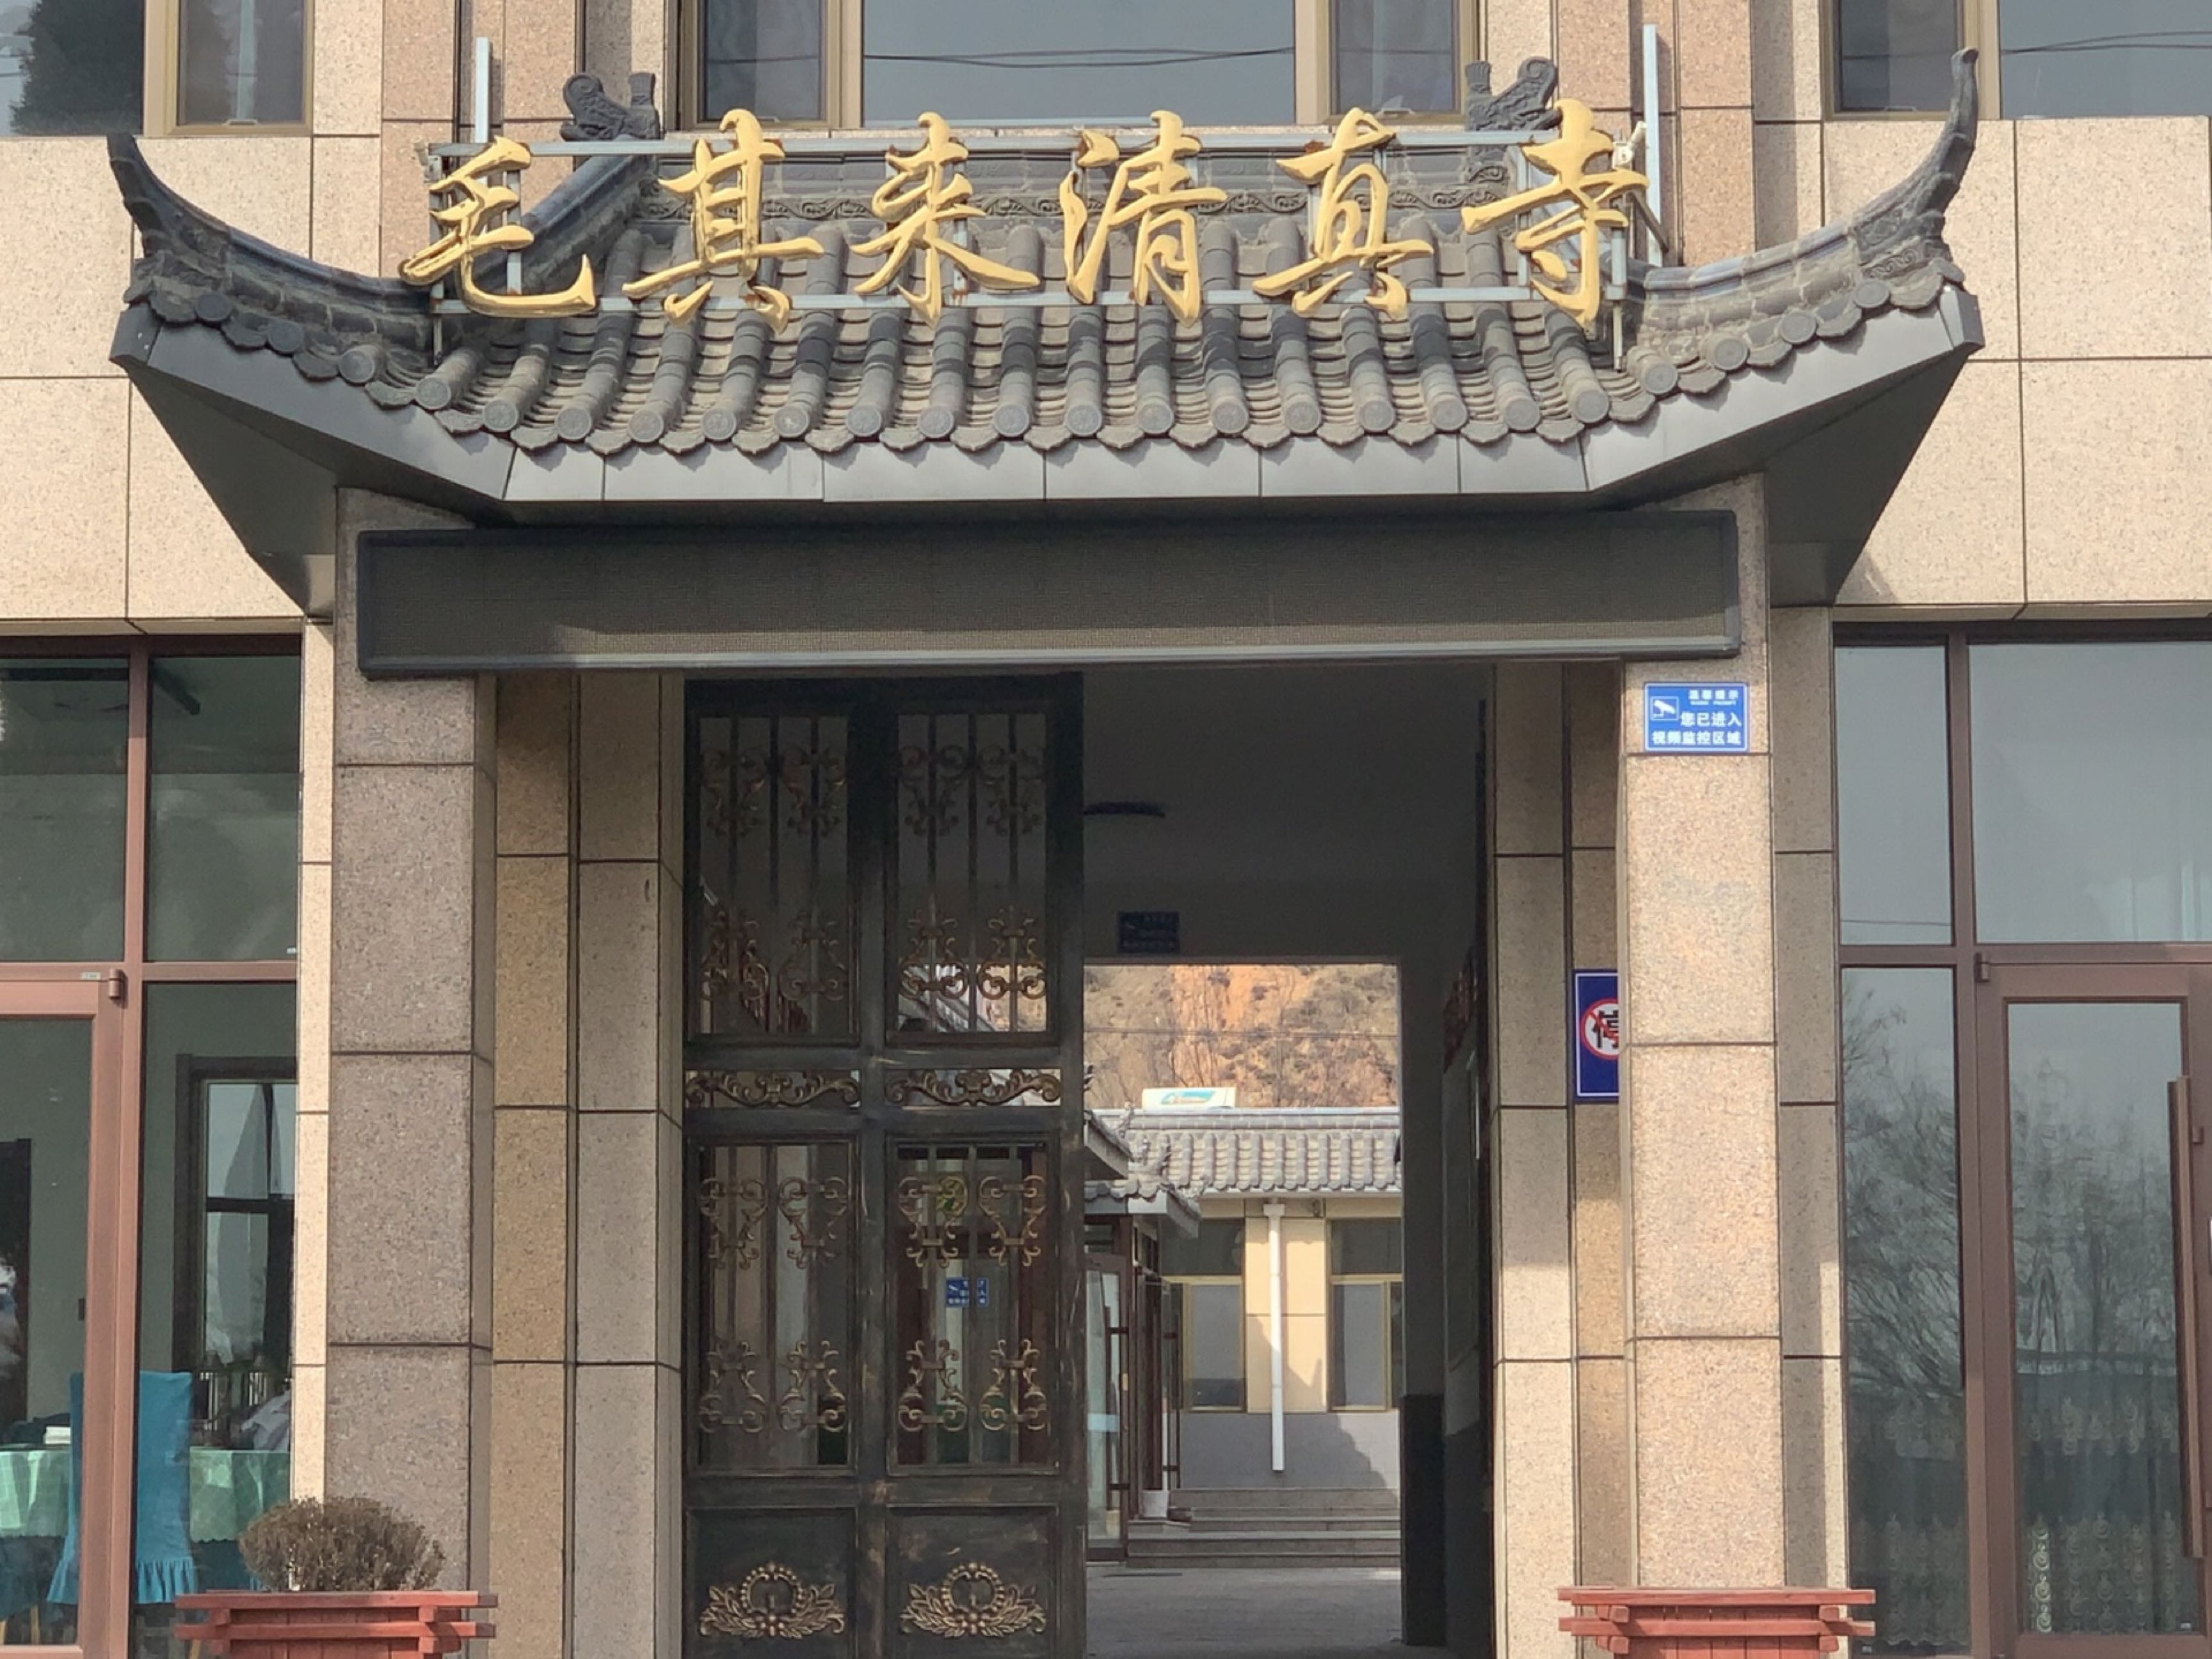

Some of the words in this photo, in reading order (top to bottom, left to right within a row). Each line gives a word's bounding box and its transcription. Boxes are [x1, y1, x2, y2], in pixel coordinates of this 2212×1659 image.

[1681, 711, 1742, 727] 您已进入
[1653, 731, 1742, 746] 视频监控区域
